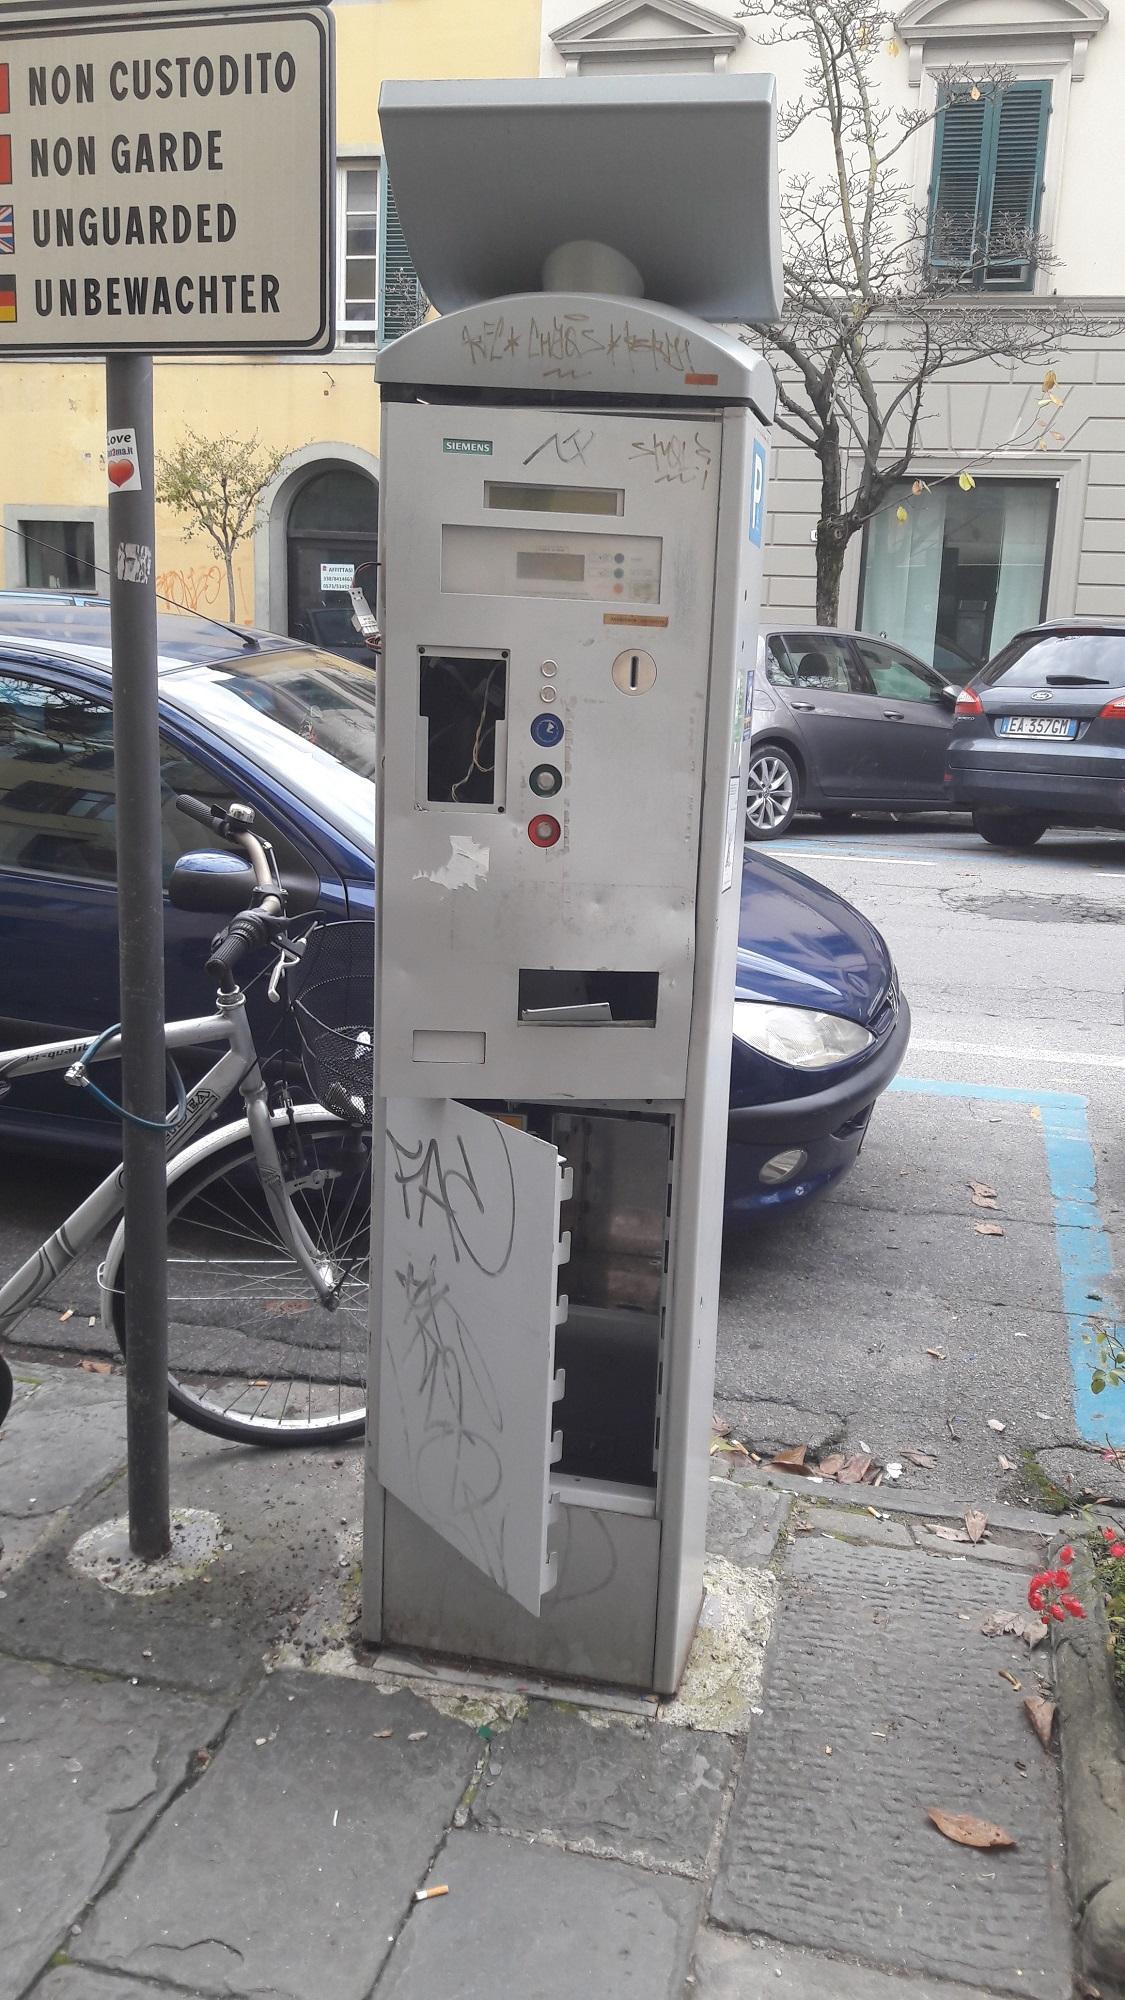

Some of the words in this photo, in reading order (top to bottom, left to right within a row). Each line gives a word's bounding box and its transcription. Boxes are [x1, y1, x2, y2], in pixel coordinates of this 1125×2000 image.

[29, 63, 94, 106] NON
[109, 51, 296, 101] CUSTODITO
[30, 135, 96, 178] NON
[111, 130, 224, 174] GARDE
[32, 203, 237, 248] UNGUARDED
[34, 274, 281, 317] UNBEWACHTER
[446, 441, 490, 452] SIEMENS
